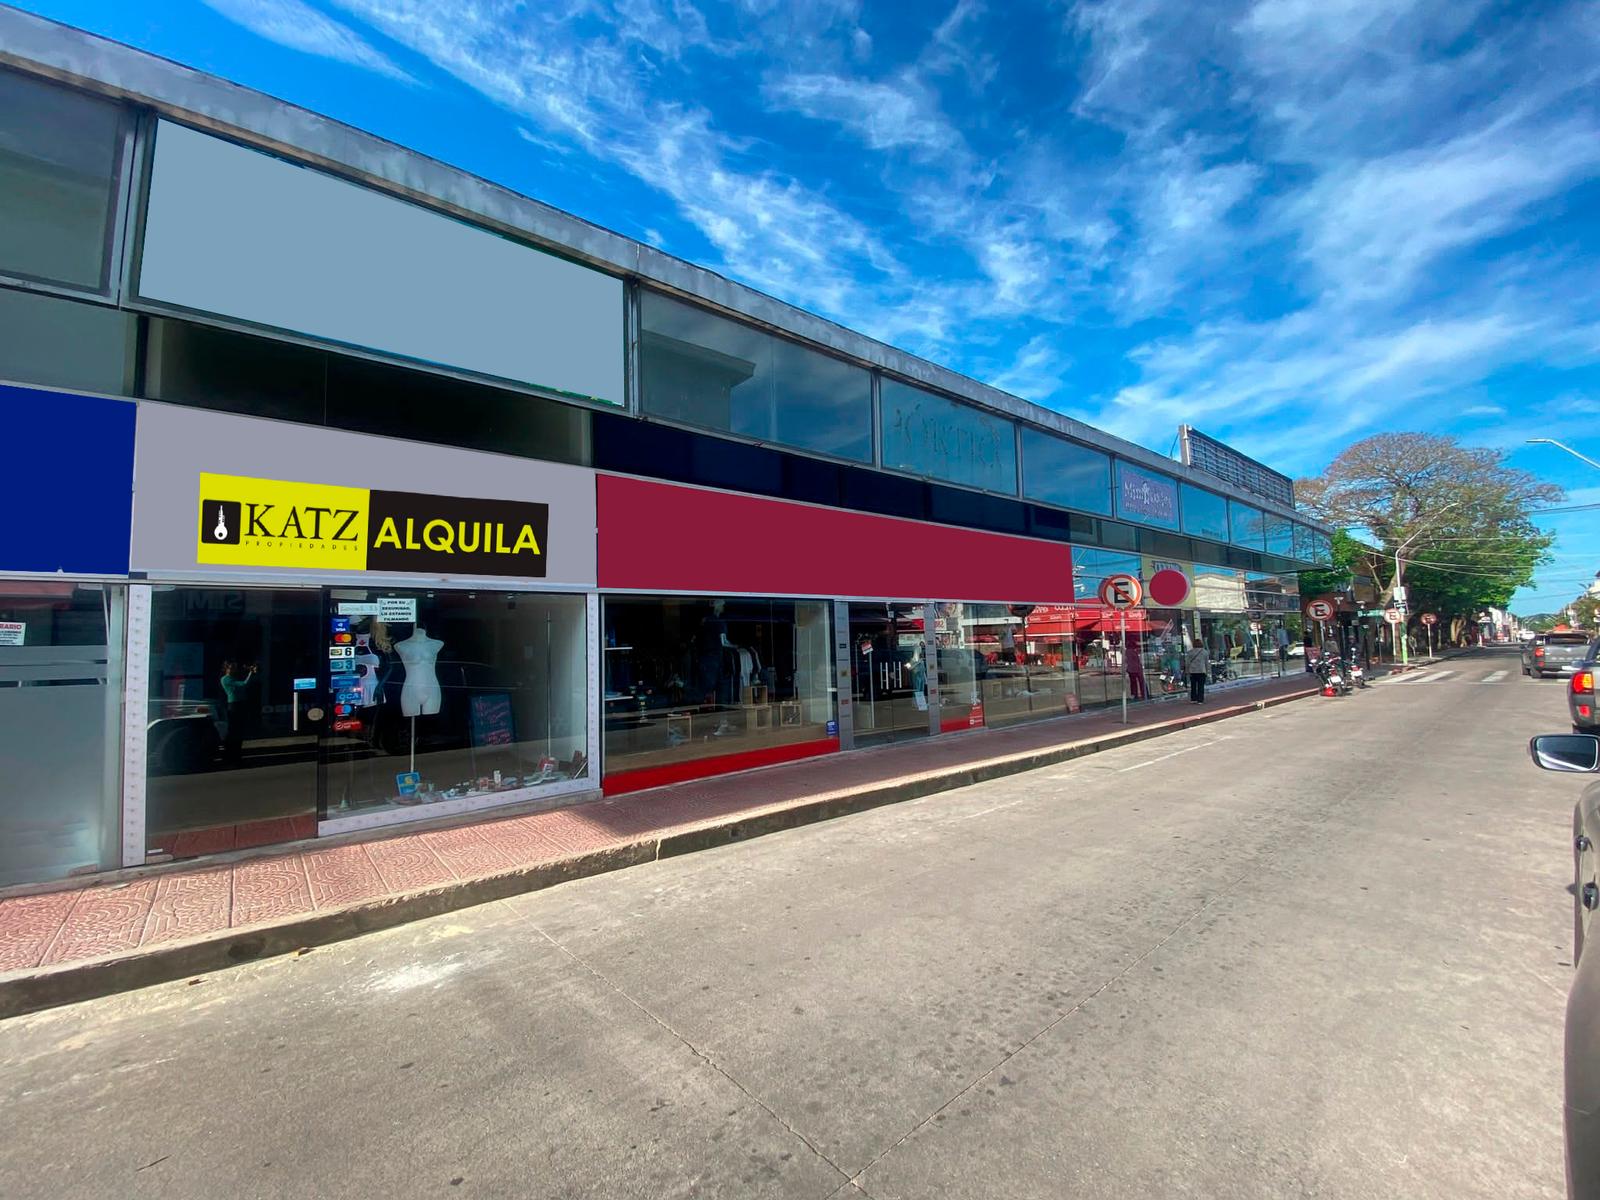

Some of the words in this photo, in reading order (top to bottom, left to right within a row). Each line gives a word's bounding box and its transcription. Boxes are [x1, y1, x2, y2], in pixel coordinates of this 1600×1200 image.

[244, 503, 360, 542] KATZ
[373, 517, 541, 555] ALQUILA
[245, 541, 358, 551] PROPIEDADES
[1114, 581, 1130, 604] E
[344, 647, 353, 656] 6
[345, 660, 353, 669] 3
[339, 693, 359, 701] OCA
